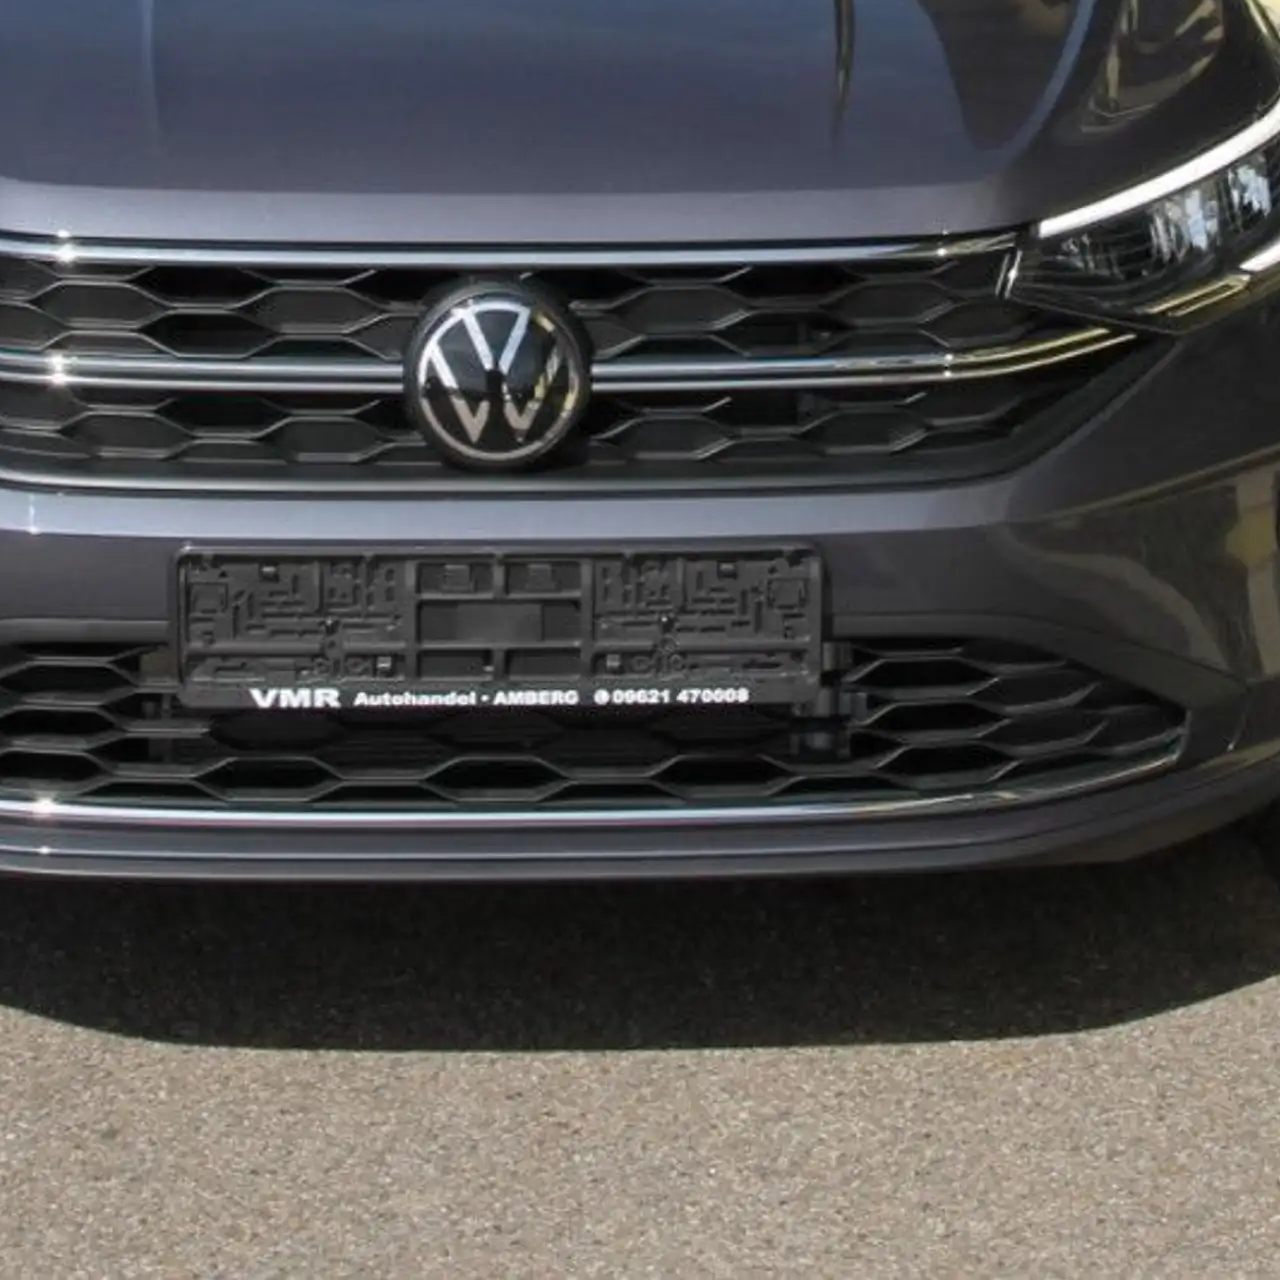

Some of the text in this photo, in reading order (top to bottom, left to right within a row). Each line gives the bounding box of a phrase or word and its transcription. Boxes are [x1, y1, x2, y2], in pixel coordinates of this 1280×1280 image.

[250, 688, 341, 708] VMR
[353, 690, 477, 706] Autohandel
[493, 689, 579, 706] AMBERG
